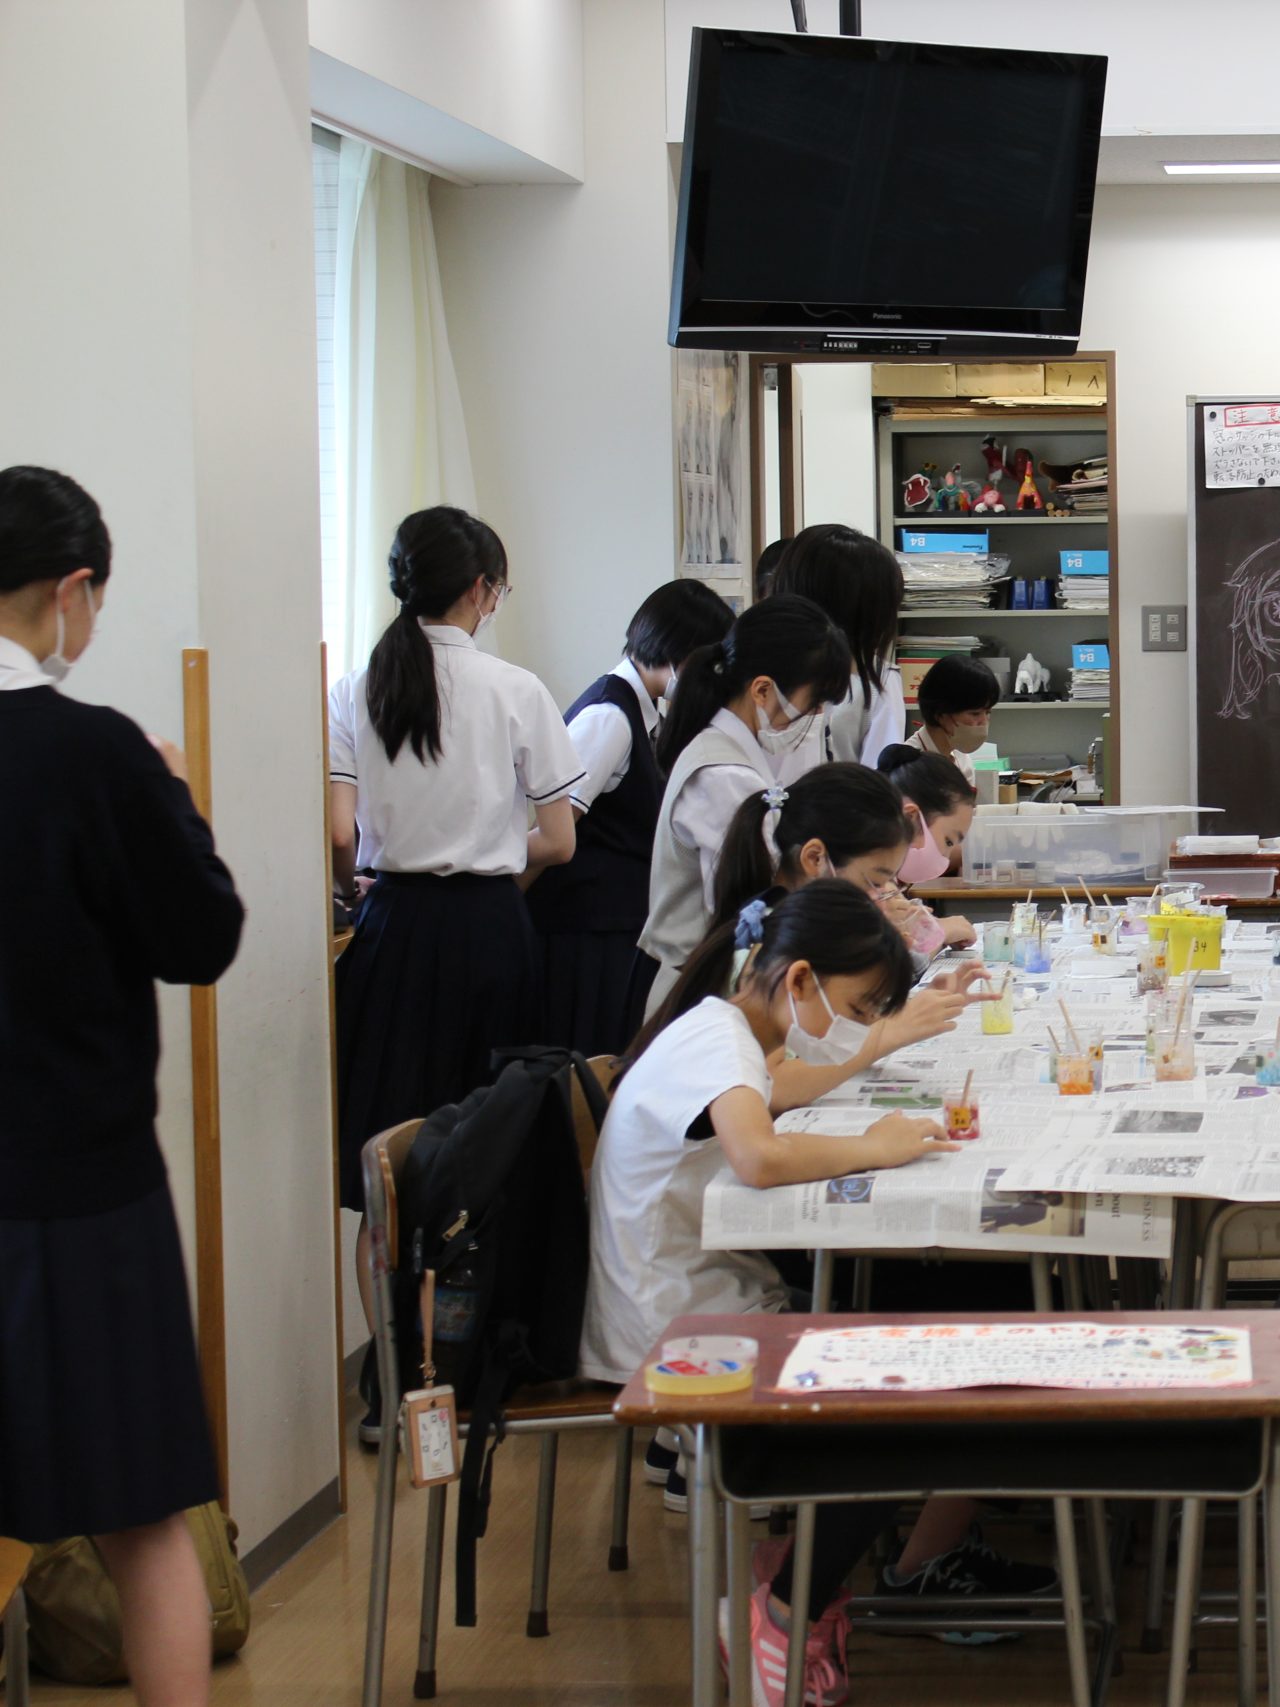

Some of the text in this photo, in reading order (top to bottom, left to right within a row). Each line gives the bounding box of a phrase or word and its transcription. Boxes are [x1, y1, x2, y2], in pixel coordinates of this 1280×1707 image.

[910, 537, 926, 547] B4
[1067, 558, 1083, 568] B4
[1079, 653, 1095, 663] B4
